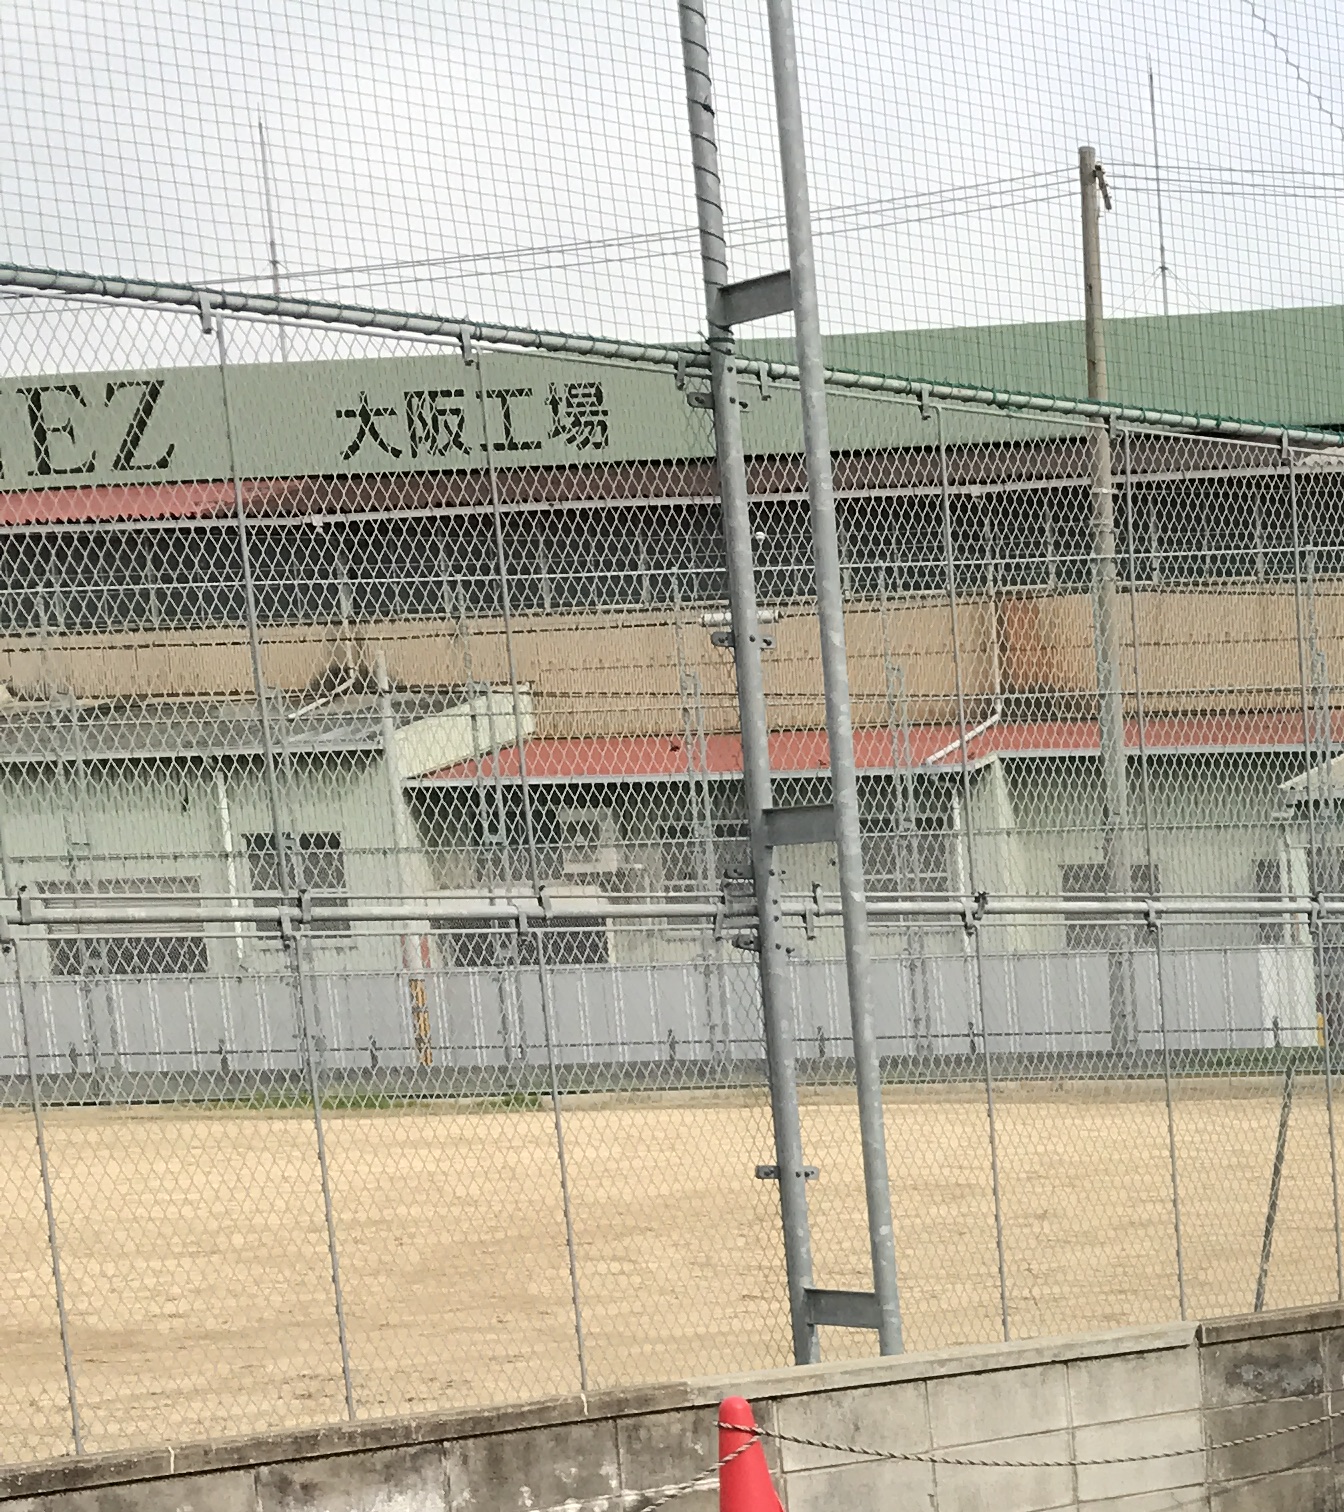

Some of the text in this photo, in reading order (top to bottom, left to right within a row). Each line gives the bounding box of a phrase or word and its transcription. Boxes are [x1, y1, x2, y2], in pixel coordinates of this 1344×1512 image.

[0, 379, 176, 480] EZ
[335, 381, 610, 460] 大阪工場
